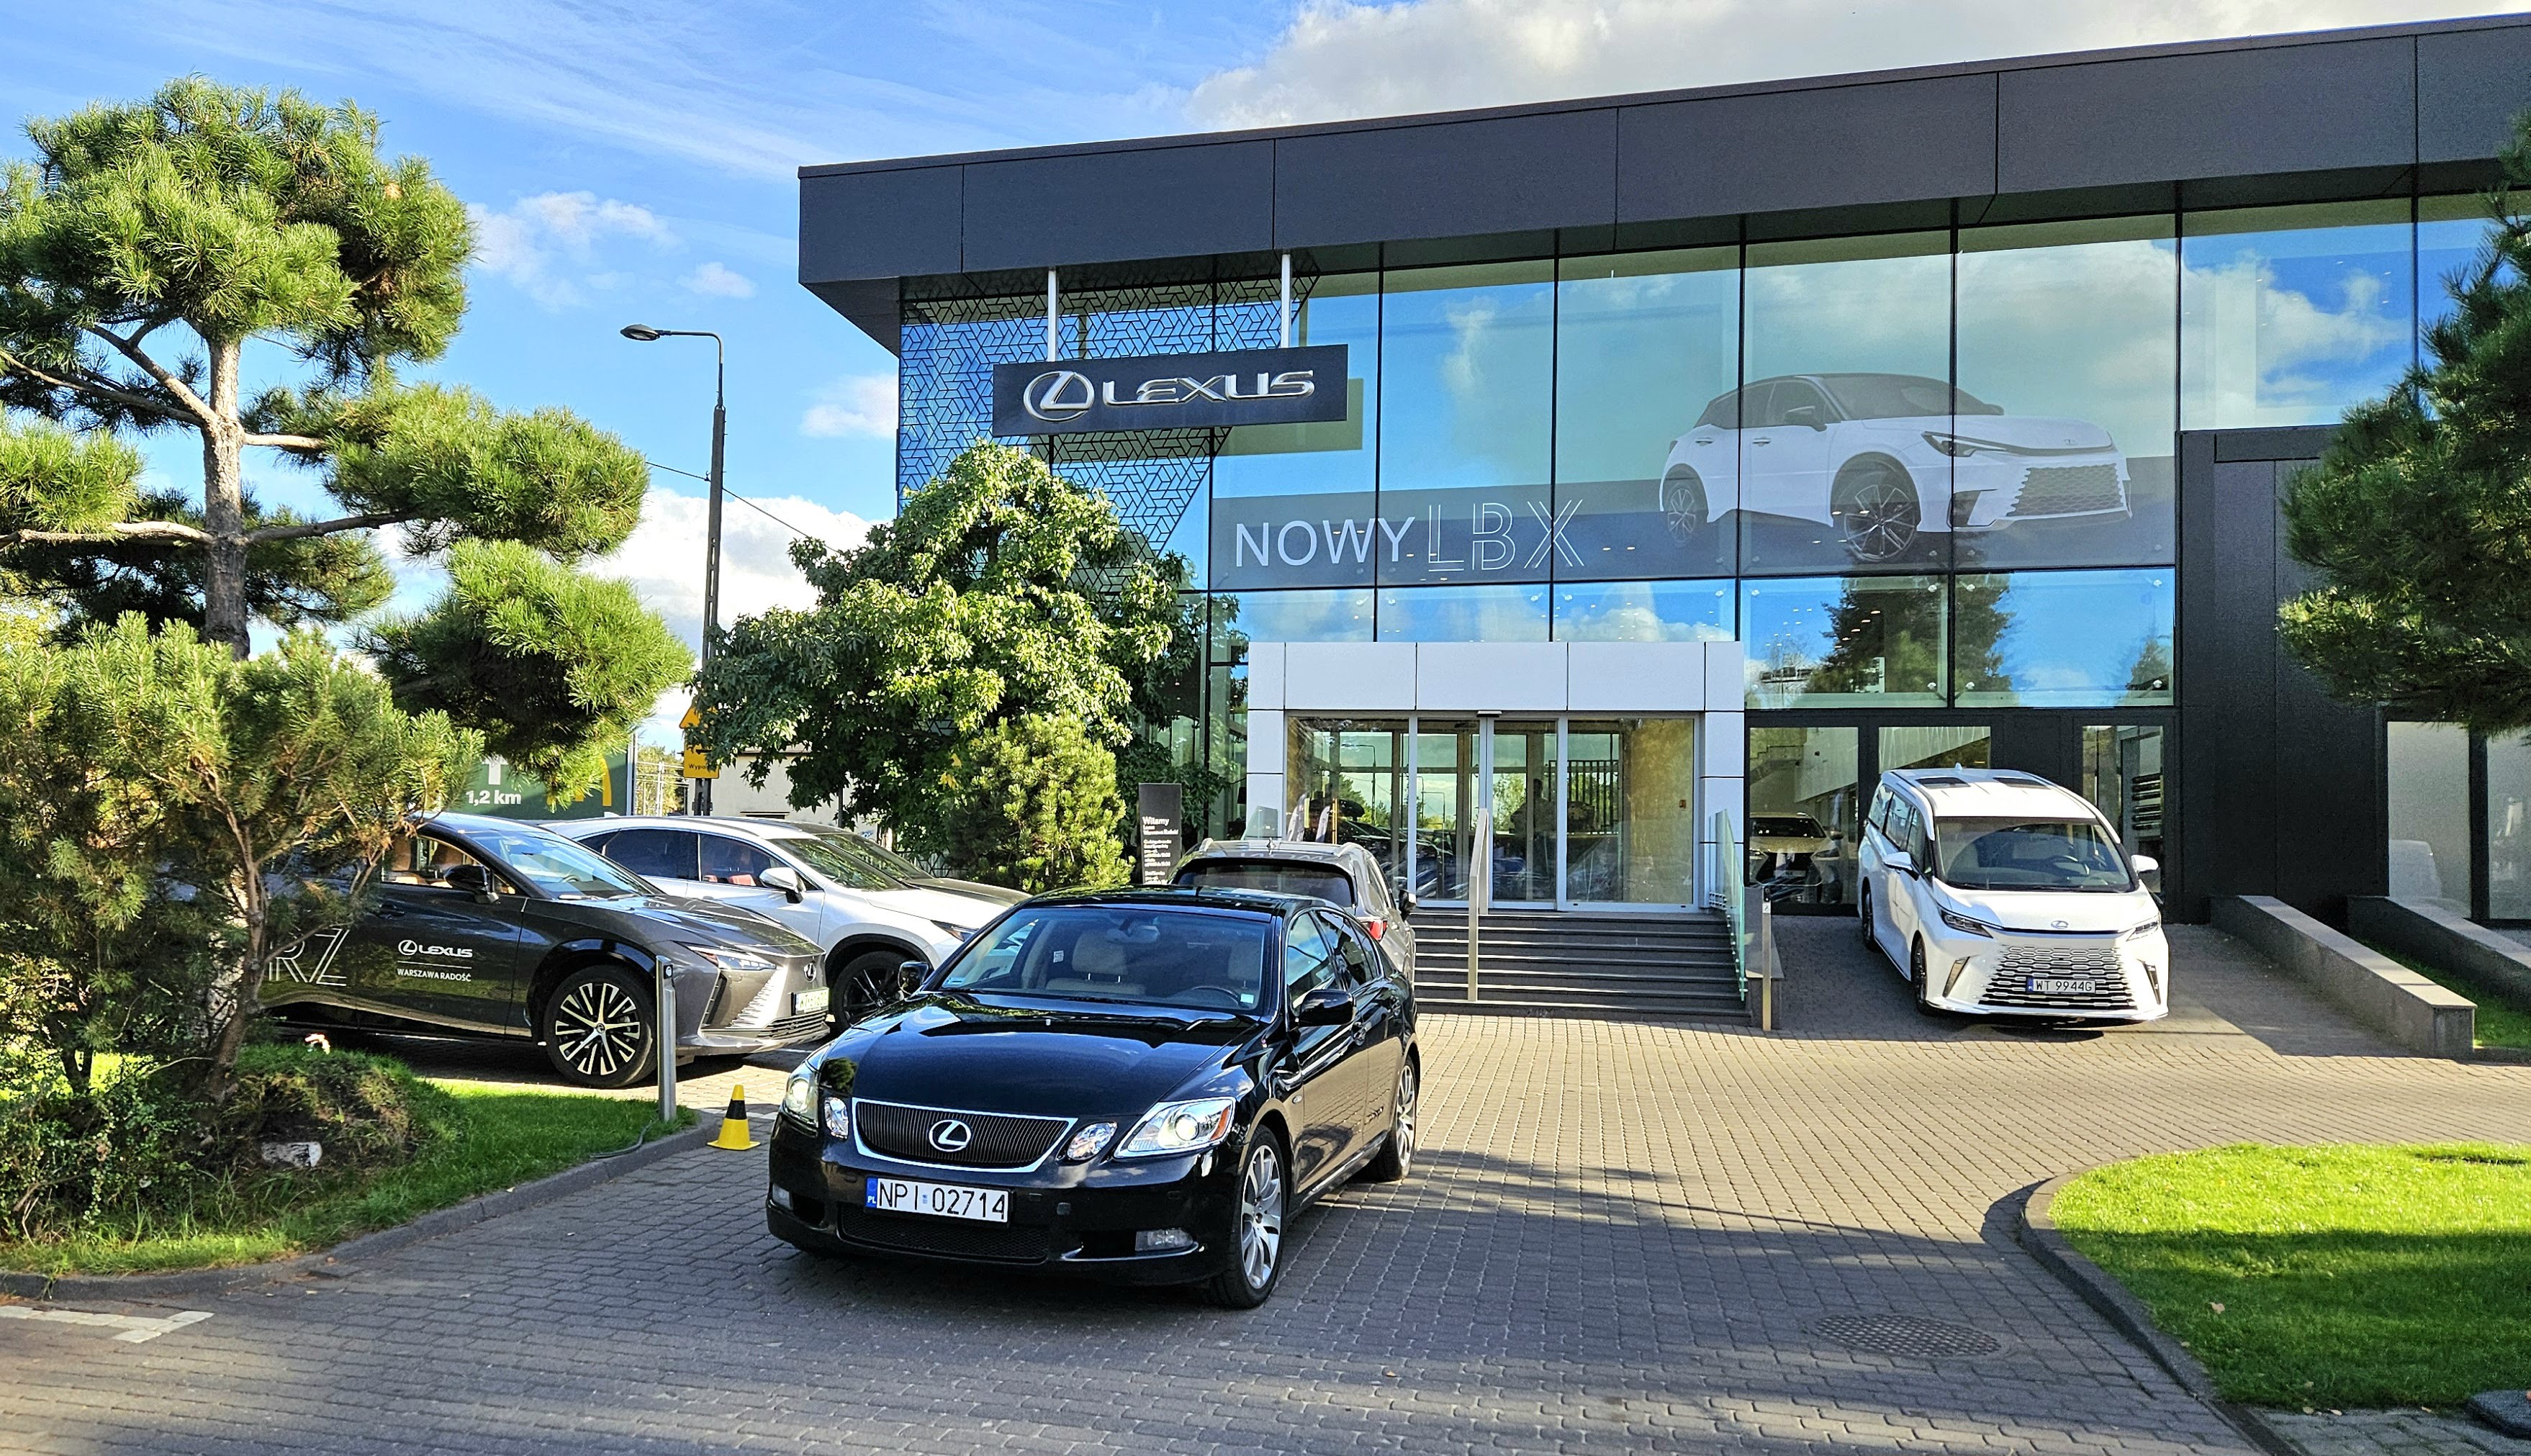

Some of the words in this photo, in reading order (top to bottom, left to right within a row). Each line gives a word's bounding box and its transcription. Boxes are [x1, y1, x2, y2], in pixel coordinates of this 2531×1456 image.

[1102, 369, 1316, 407] LEXUS
[1235, 516, 1416, 568] NOWY
[1427, 499, 1585, 572] LBX
[465, 790, 491, 806] 1,2
[494, 790, 522, 805] km
[418, 944, 473, 958] LEXUS
[397, 967, 440, 980] WARSZAWA
[440, 972, 472, 982] RADOŚĆ
[2036, 980, 2051, 991] WT
[2055, 980, 2093, 992] 9944G
[867, 1195, 877, 1204] PL
[878, 1181, 919, 1211] NPI
[931, 1187, 1006, 1220] 02714
